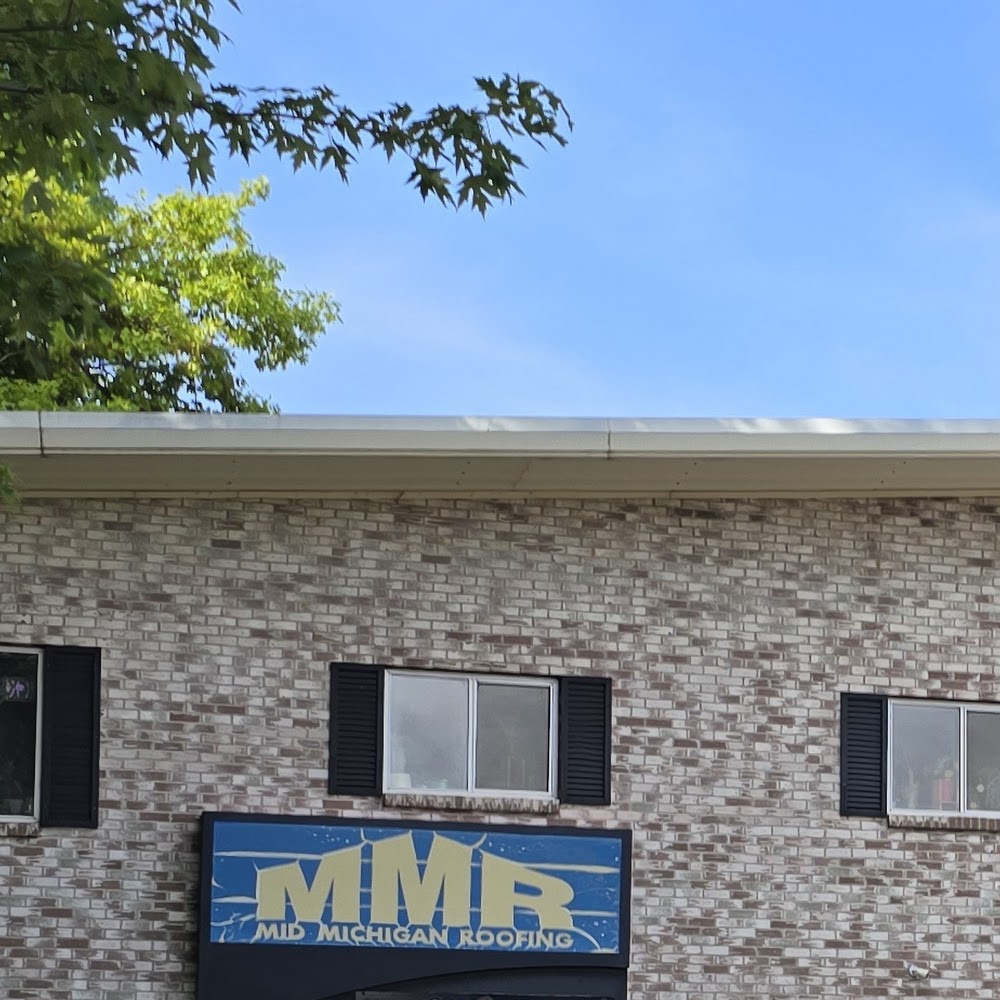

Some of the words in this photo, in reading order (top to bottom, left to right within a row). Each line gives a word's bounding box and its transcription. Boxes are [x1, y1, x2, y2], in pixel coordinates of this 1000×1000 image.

[256, 832, 575, 930] MMR
[255, 923, 306, 941] MID
[316, 923, 448, 945] MICHIGAN
[459, 928, 574, 949] ROOFING
